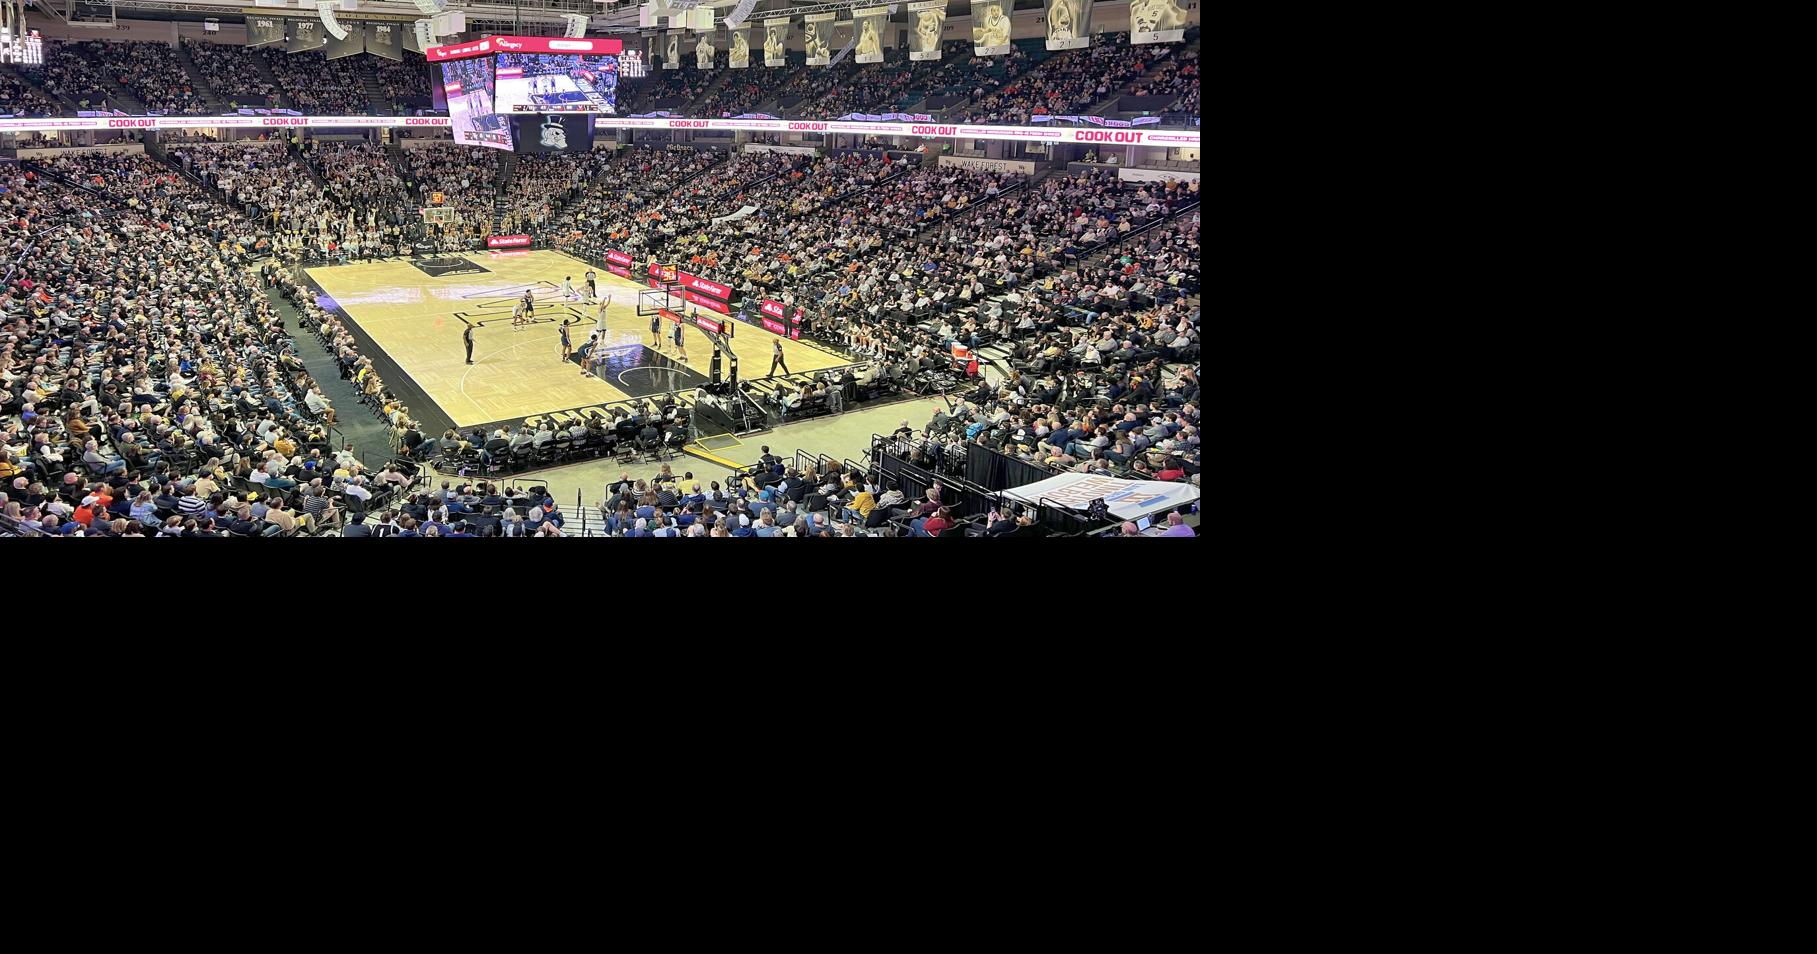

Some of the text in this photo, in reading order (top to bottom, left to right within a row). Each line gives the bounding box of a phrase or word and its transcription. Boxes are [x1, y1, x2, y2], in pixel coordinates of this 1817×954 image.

[256, 20, 273, 28] 1961
[297, 22, 314, 30] 1977
[376, 25, 391, 33] 1984
[1153, 33, 1159, 41] 5
[1059, 40, 1072, 49] 21
[108, 119, 136, 127] COOK
[138, 119, 156, 127] OUT
[788, 122, 812, 130] COOK
[812, 122, 828, 130] OUT
[911, 126, 937, 135] COOK
[938, 127, 957, 135] OUT
[1075, 130, 1113, 142] COOK
[1115, 132, 1143, 143] OUT
[962, 160, 980, 168] WAKE
[981, 161, 1007, 170] FOREST
